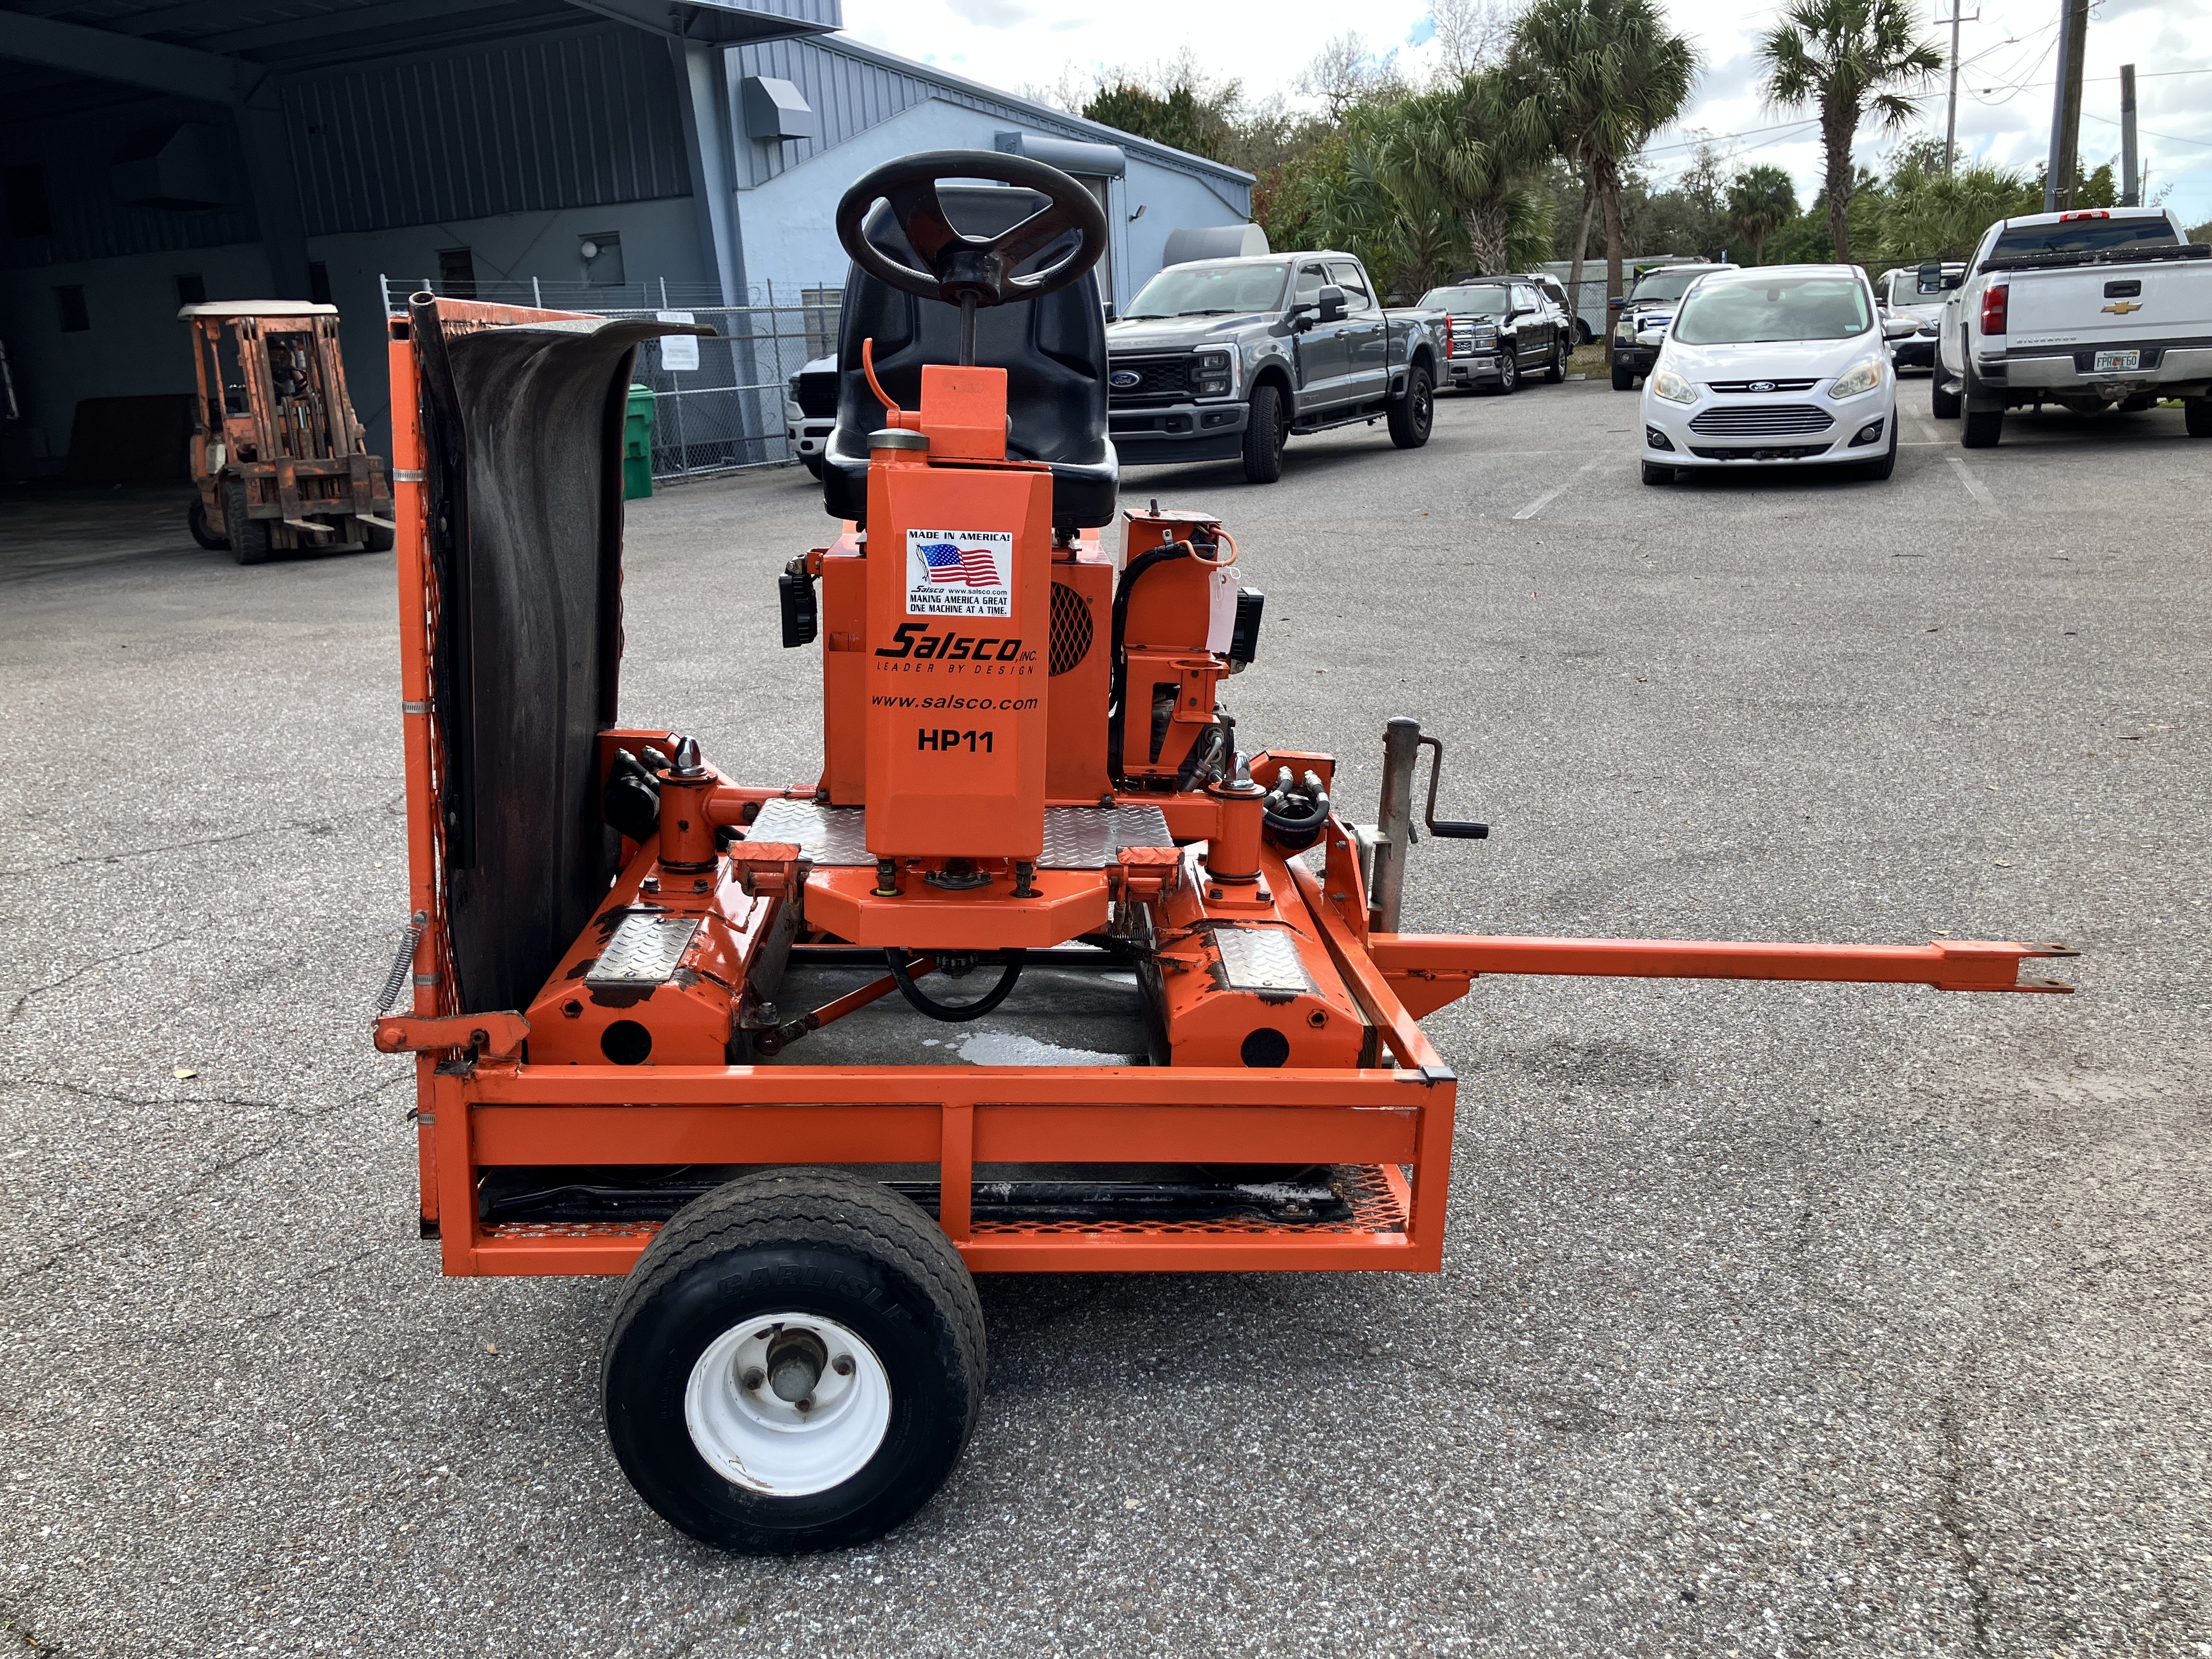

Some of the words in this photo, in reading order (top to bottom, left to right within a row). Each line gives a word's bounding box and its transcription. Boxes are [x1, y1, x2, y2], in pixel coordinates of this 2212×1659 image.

[2017, 335, 2076, 344] SILVERADO
[1115, 375, 1132, 384] Ford
[909, 531, 939, 539] MADE
[960, 533, 1010, 541] AMERICA!
[910, 595, 941, 603] MAKING
[945, 596, 979, 605] AMERICA
[983, 597, 1008, 605] GREAT
[911, 604, 926, 612] ONE
[929, 605, 963, 613] MACHINE
[988, 606, 1007, 614] TIME.
[877, 662, 934, 673] LEADER
[948, 664, 966, 674] BY
[974, 665, 1034, 675] DESIGN
[872, 695, 1038, 710] www.salsco.com
[918, 729, 993, 753] HP11
[718, 1264, 912, 1328] CARLISLE
